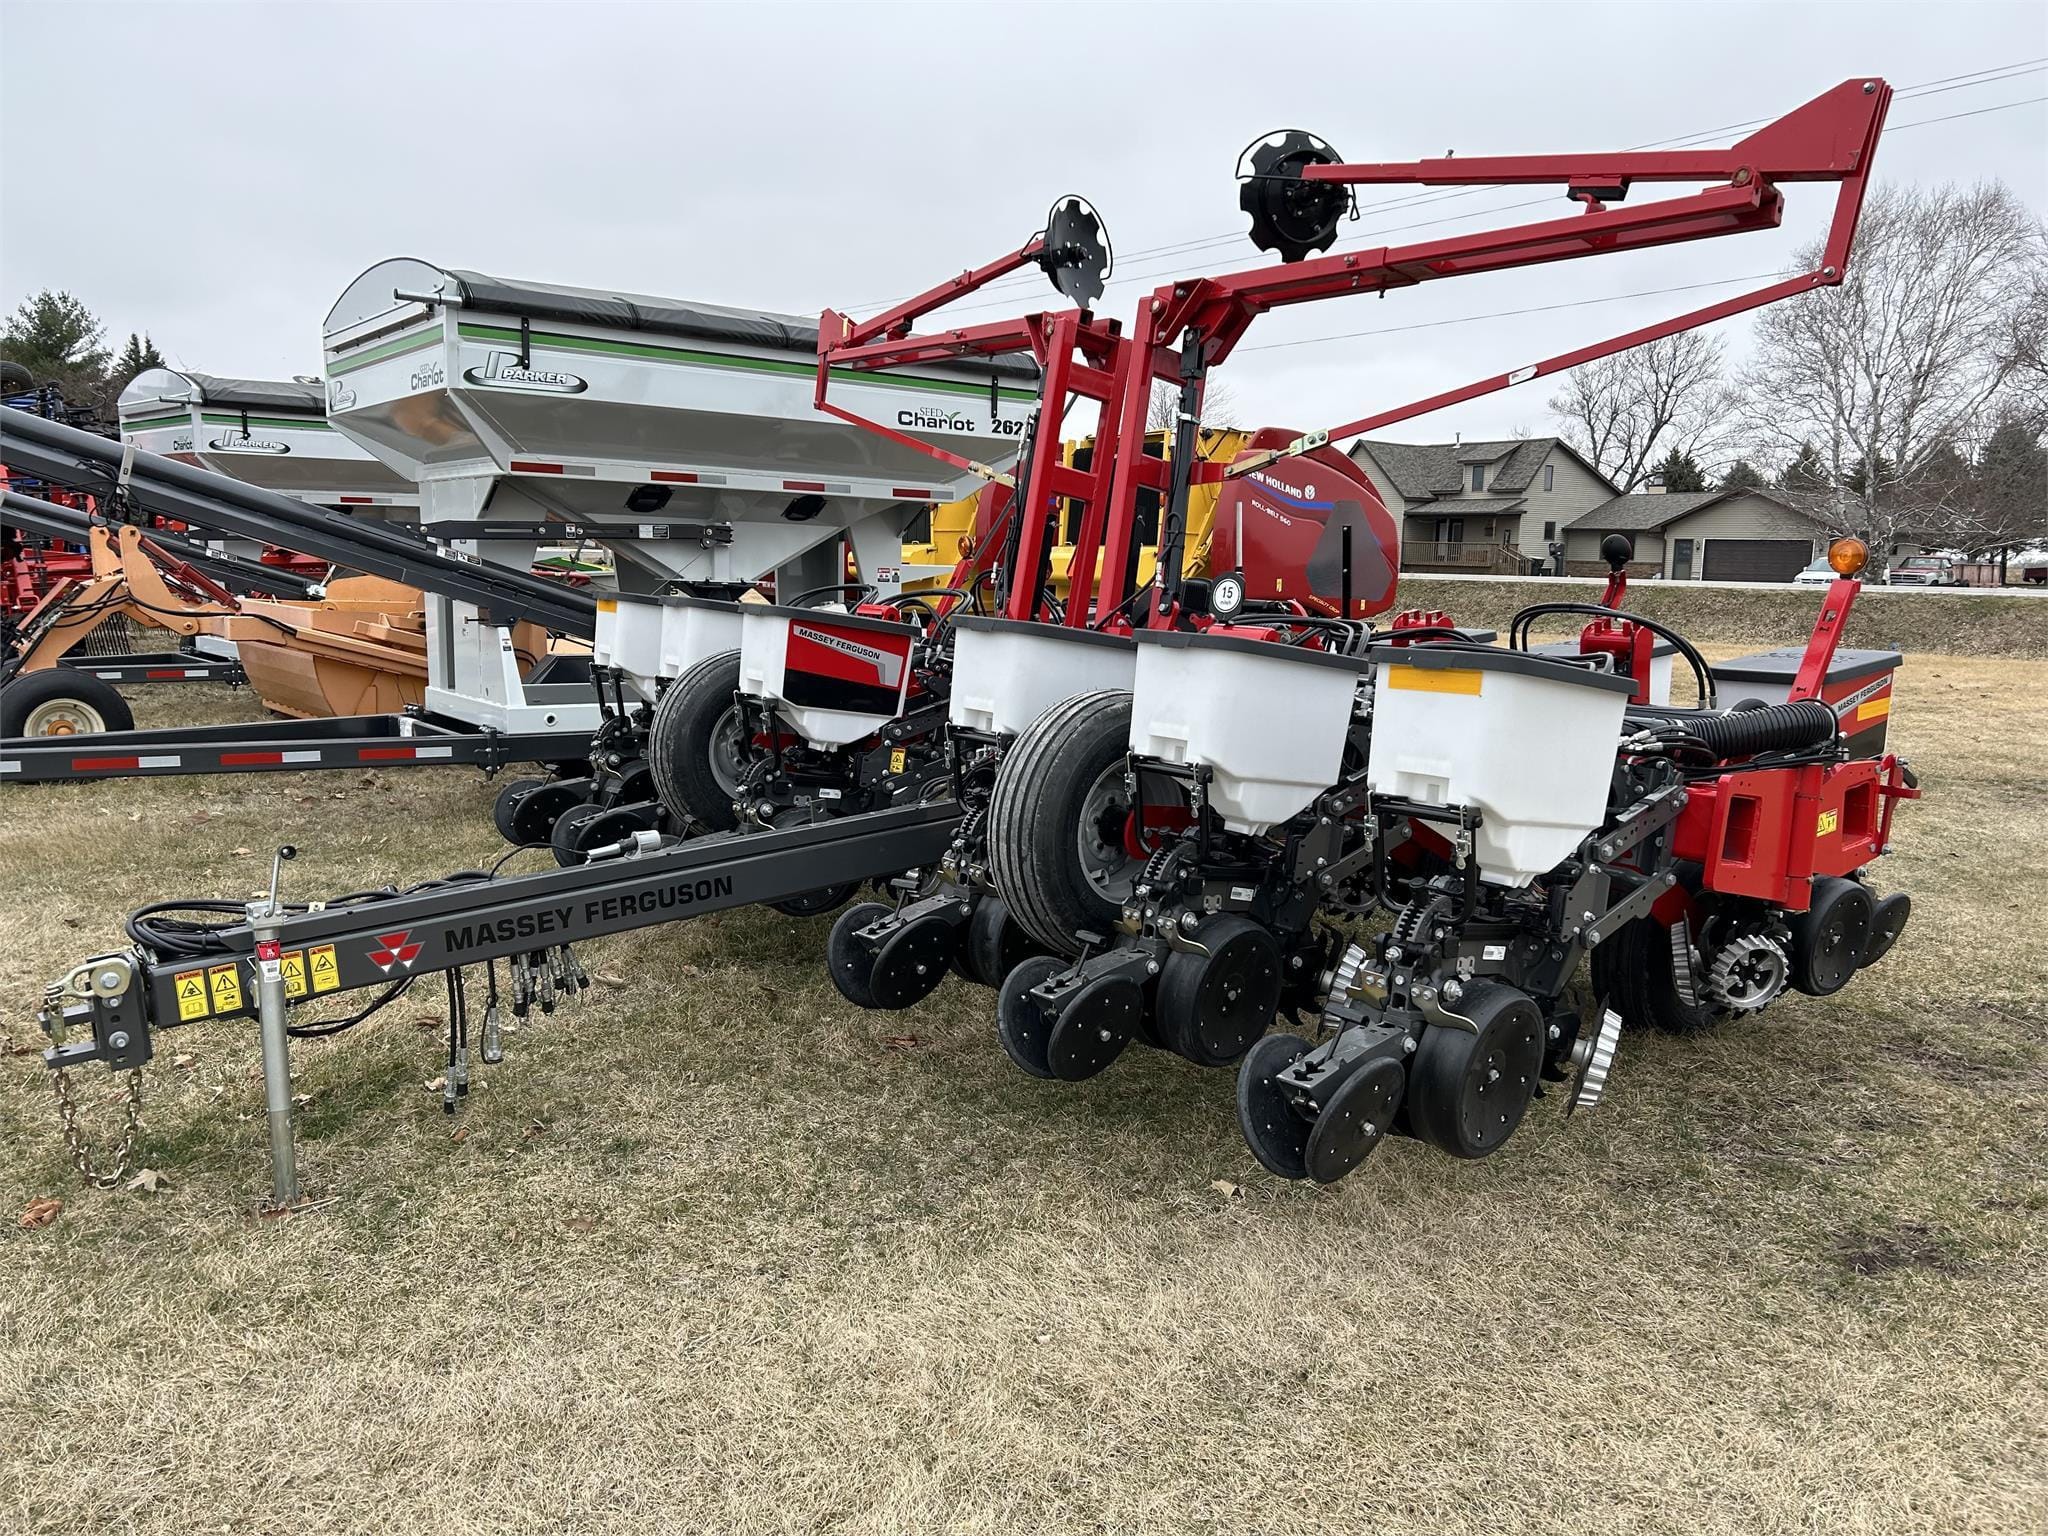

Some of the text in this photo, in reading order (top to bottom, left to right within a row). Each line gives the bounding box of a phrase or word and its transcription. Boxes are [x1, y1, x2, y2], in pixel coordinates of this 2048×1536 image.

[410, 367, 444, 391] Chariot
[501, 368, 568, 384] PARKER
[897, 410, 975, 432] Chariot
[919, 406, 944, 418] SEED
[991, 419, 1028, 436] 262
[234, 440, 278, 449] PARKER
[1265, 475, 1302, 499] HOLLAND
[1222, 586, 1234, 599] 15
[799, 628, 881, 660] MASSEY FERGUSON
[1837, 676, 1889, 713] MASSEY FERGUSON
[444, 875, 733, 953] MASSEY FERGUSON
